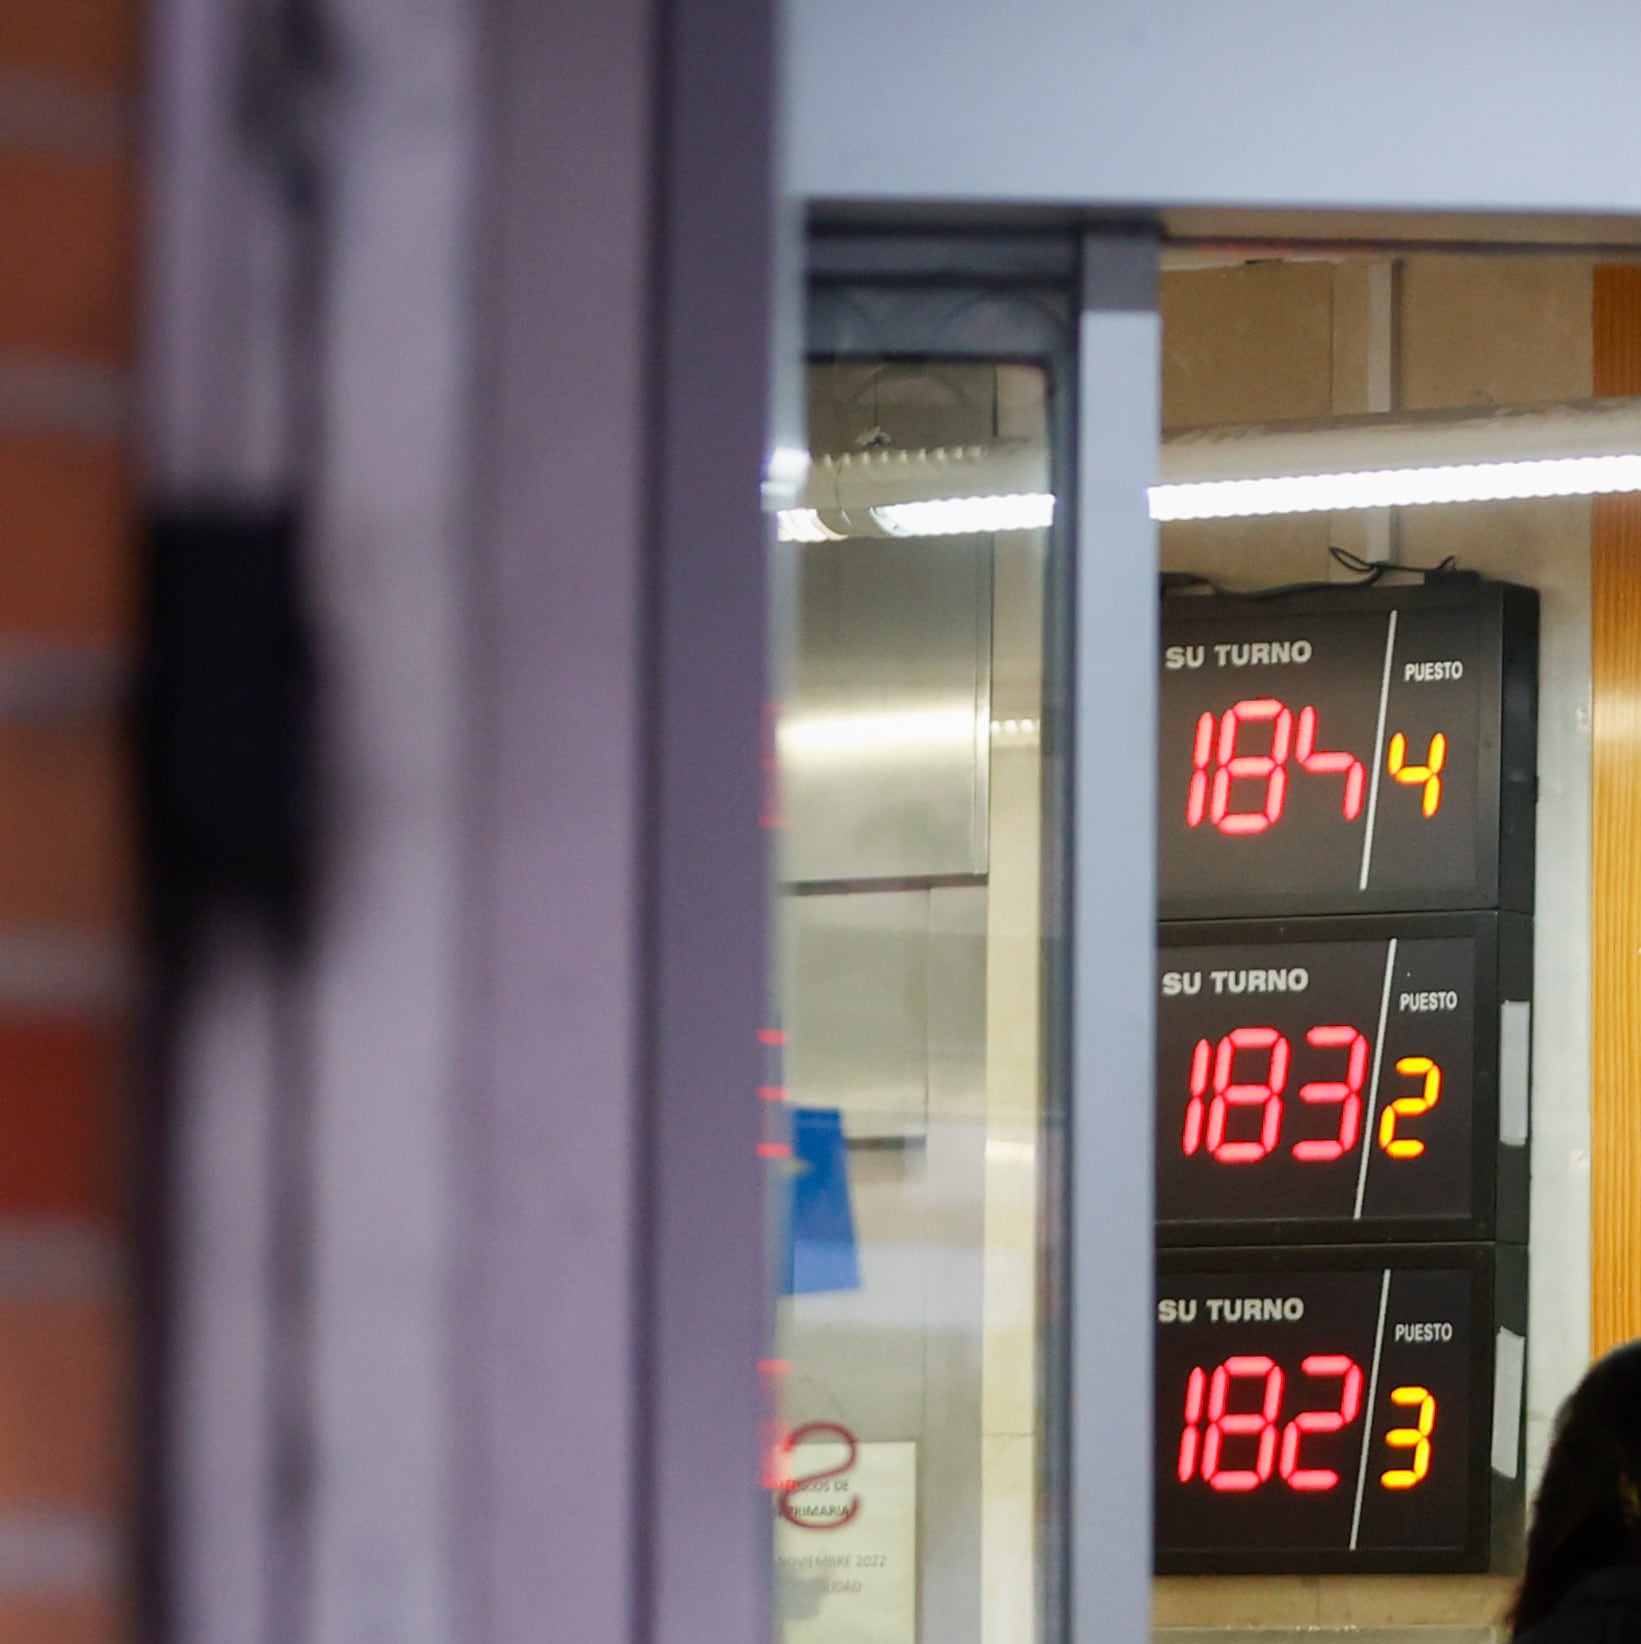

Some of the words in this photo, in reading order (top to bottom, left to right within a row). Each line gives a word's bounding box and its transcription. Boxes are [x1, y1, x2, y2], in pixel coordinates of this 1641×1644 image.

[1165, 645, 1205, 669] SU
[1213, 640, 1312, 667] TURNO
[1404, 660, 1463, 682] PUESTO
[1387, 732, 1448, 818] 4
[1162, 971, 1201, 996] SU
[1211, 967, 1309, 993] TURNO
[1400, 991, 1458, 1012] PUESTO
[1183, 1025, 1369, 1163] 183
[1379, 1056, 1442, 1159] 2
[1158, 1299, 1197, 1324] SU
[1206, 1296, 1304, 1323] TURNO
[1395, 1321, 1453, 1342] PUESTO
[1177, 1355, 1364, 1493] 182
[1380, 1386, 1436, 1490] 3
[856, 1555, 887, 1568] 2022
